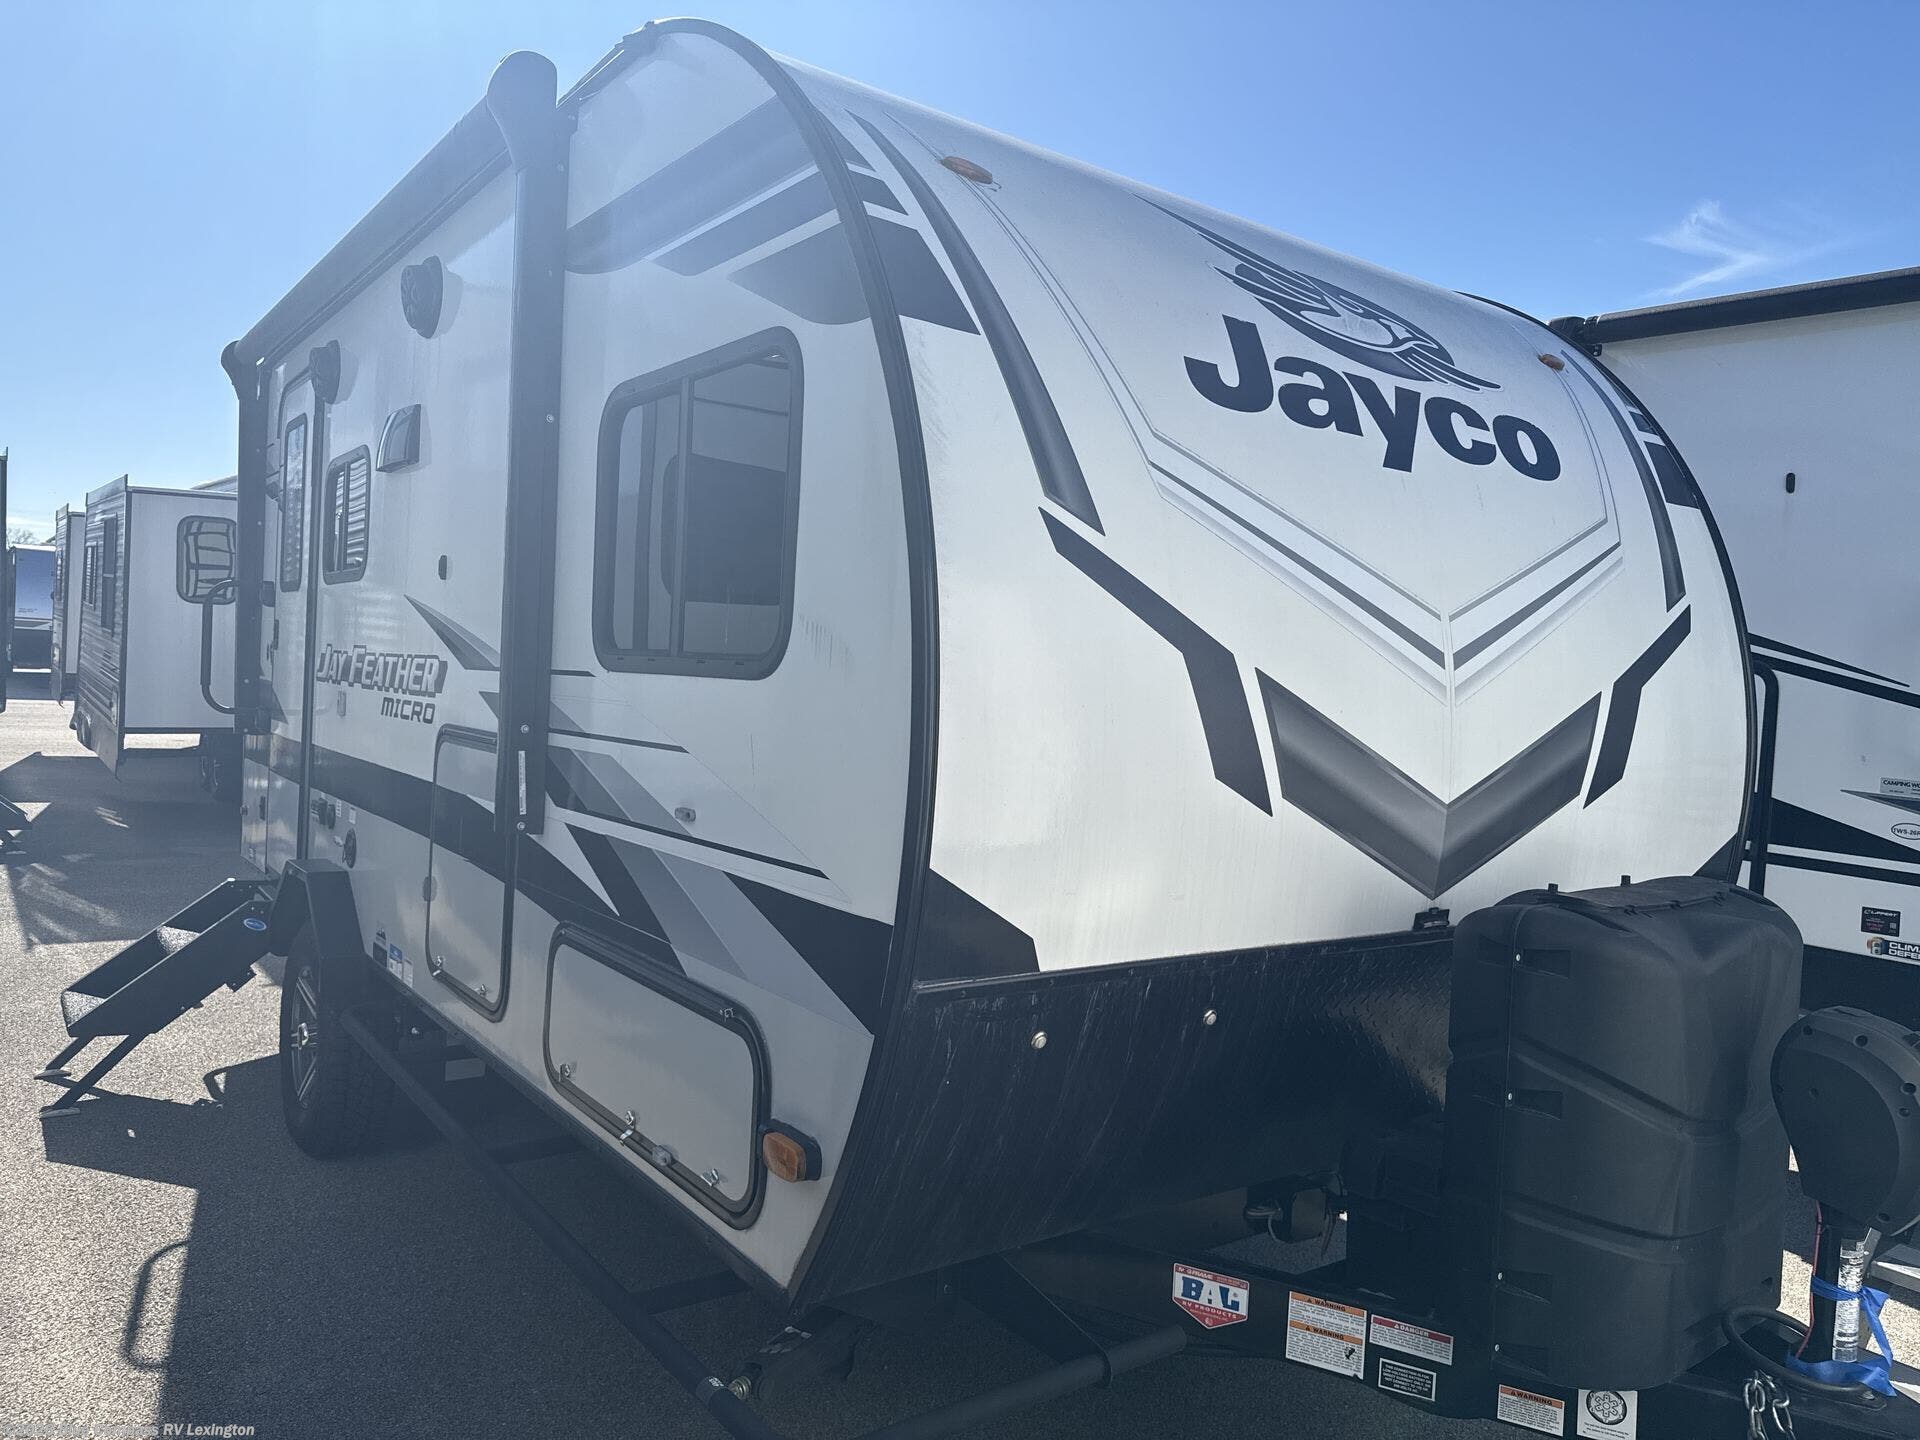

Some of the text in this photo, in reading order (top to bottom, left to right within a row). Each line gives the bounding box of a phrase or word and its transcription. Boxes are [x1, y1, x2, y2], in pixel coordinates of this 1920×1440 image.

[1183, 314, 1561, 482] Jayco
[348, 645, 441, 698] FEATHER
[381, 696, 436, 724] MICRO
[1889, 941, 1920, 953] CLIM
[1181, 1276, 1240, 1312] BAL
[1194, 1303, 1238, 1320] PRODUCTS
[1314, 1298, 1346, 1312] WARNING
[1312, 1326, 1345, 1340] WARNING
[1399, 1325, 1430, 1338] DANGER
[1517, 1390, 1552, 1406] WARNING
